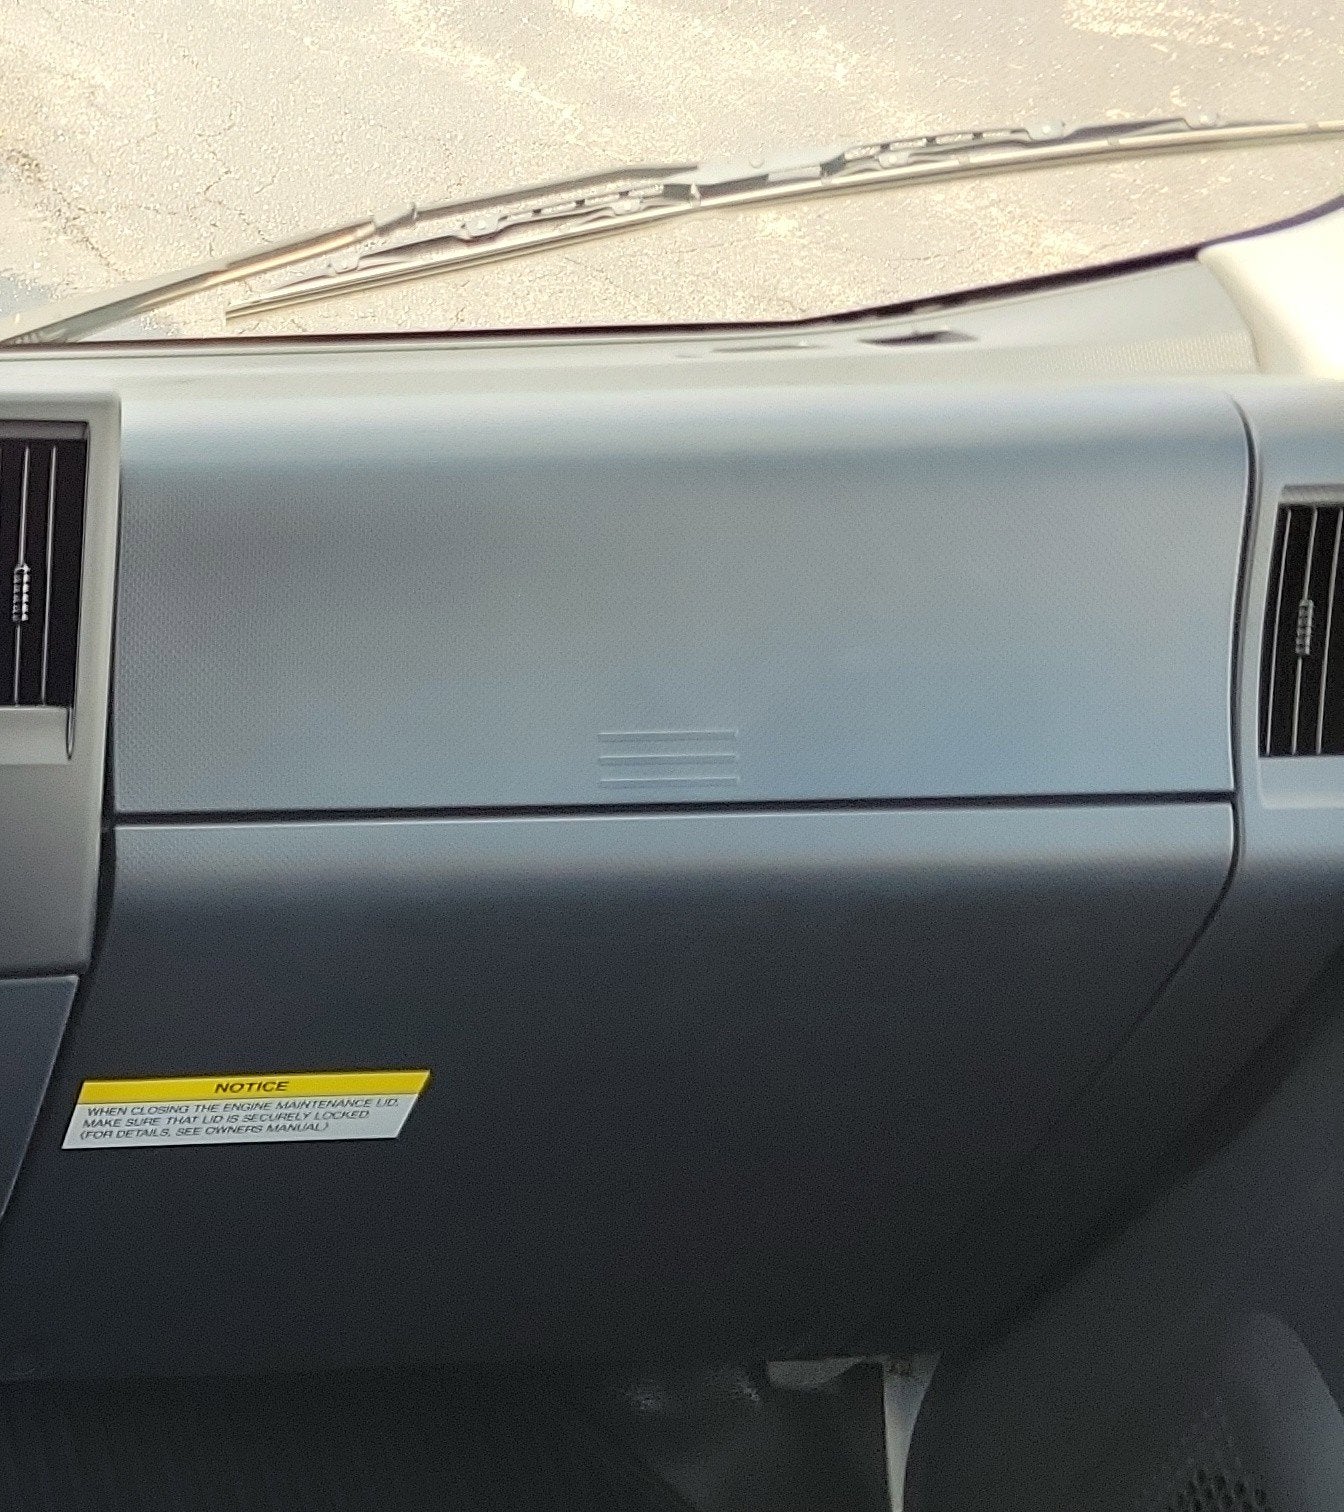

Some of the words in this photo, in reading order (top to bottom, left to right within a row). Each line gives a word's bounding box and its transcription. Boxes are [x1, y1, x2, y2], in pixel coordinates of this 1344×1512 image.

[214, 1081, 289, 1093] NOTICE
[88, 1106, 127, 1116] WHEN
[131, 1104, 189, 1115] CLOSING
[194, 1103, 220, 1113] THE
[223, 1102, 270, 1112] ENGINE
[276, 1098, 374, 1109] MAINTENANCE
[82, 1118, 122, 1127] MAKE
[125, 1117, 161, 1126] SURE
[167, 1116, 198, 1125] THAT
[201, 1115, 224, 1123] LID
[226, 1114, 239, 1123] IS
[242, 1111, 311, 1122] SECURELY
[80, 1130, 112, 1140] (FOR
[175, 1127, 201, 1136] SEE
[266, 1122, 330, 1132] MANUAL)
